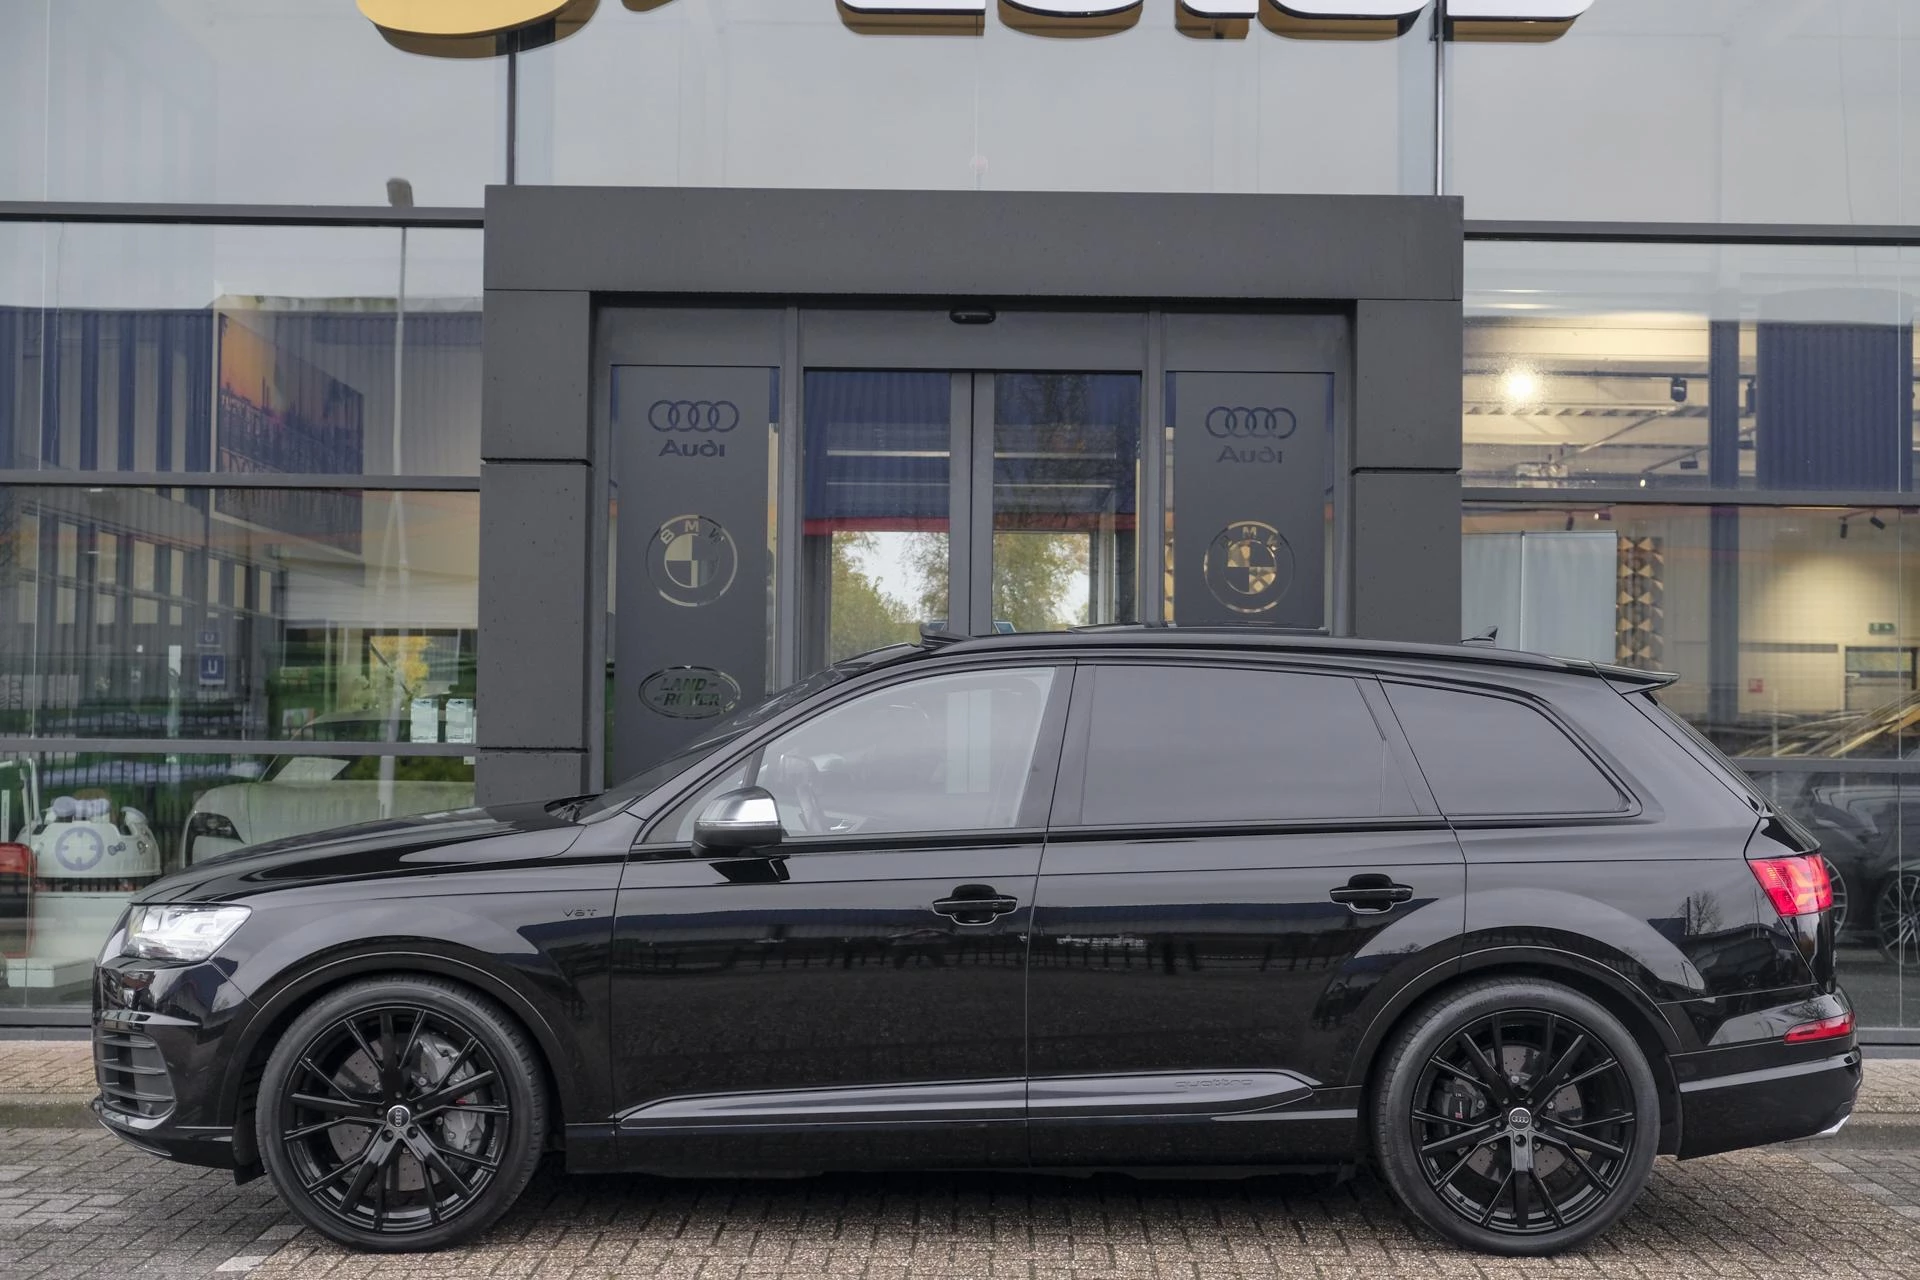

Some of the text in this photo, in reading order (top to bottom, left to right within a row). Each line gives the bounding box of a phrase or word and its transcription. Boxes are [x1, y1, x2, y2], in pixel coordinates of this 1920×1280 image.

[658, 439, 725, 457] Audi
[1216, 445, 1283, 464] Audi
[1174, 1077, 1254, 1088] quattro
